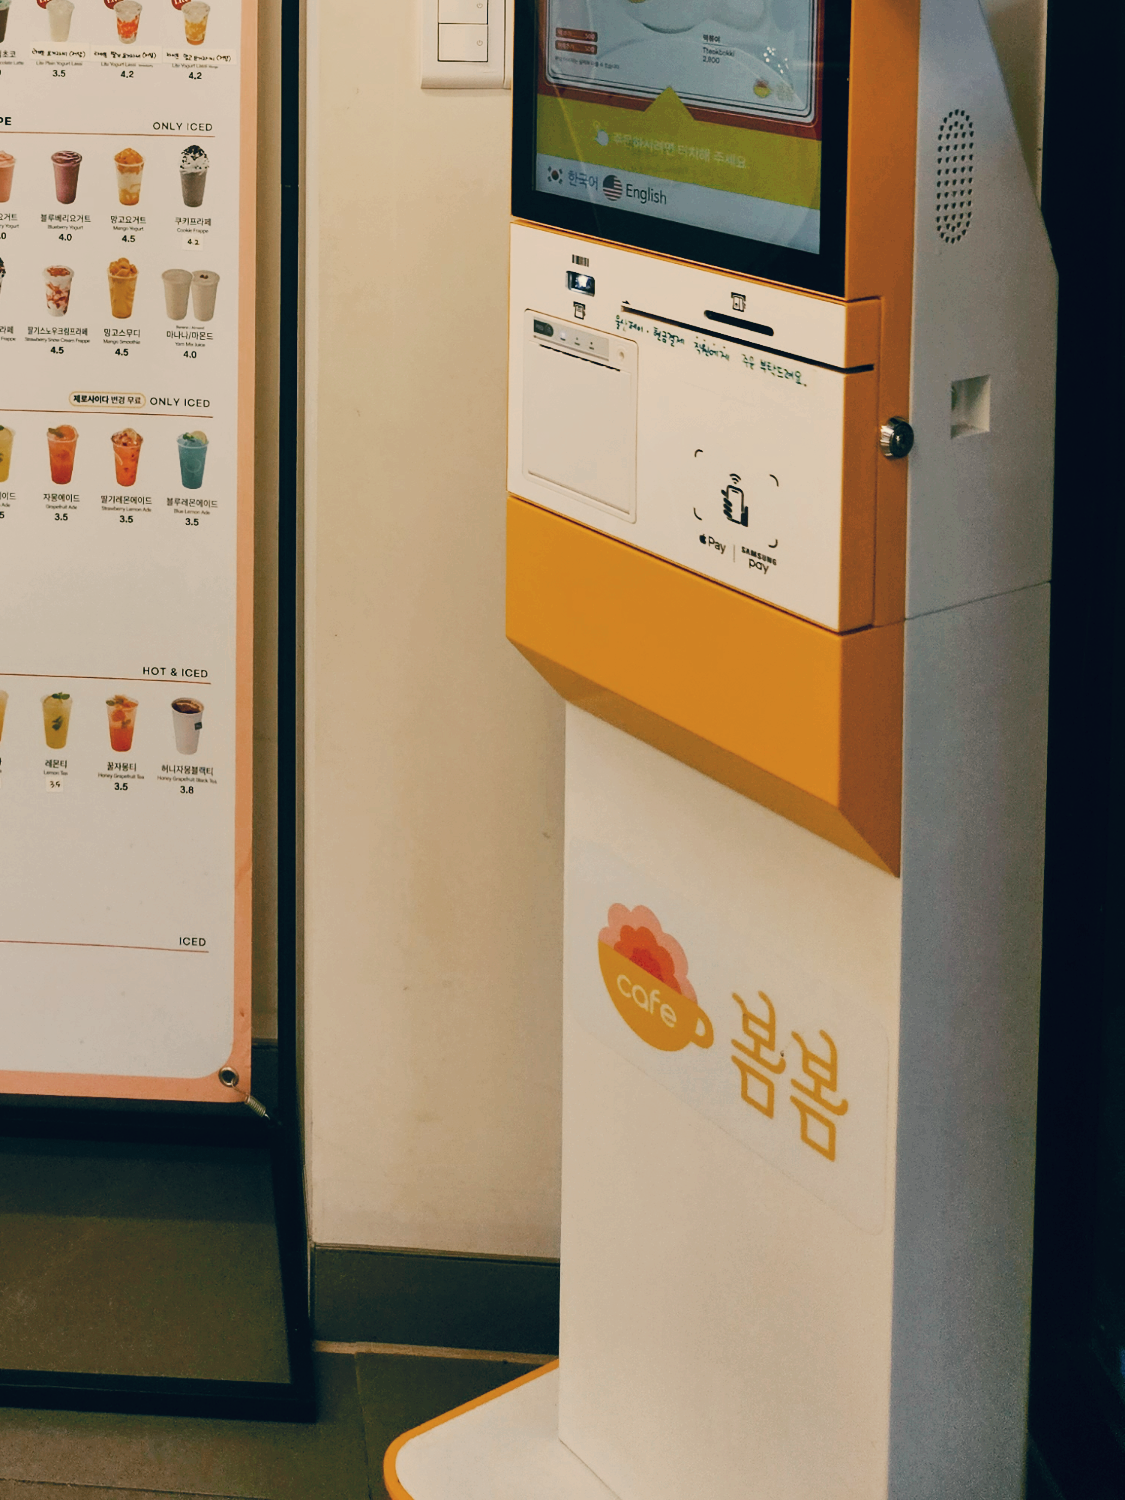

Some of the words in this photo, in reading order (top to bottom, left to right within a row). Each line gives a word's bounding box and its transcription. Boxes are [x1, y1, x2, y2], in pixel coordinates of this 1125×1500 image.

[153, 122, 183, 132] ONLY
[186, 122, 213, 132] ICED
[567, 170, 599, 190] 한국어
[625, 184, 667, 205] English
[111, 215, 147, 224] 망고요거트
[73, 394, 109, 404] 제로사이다
[111, 396, 125, 404] 변경
[127, 396, 141, 404] 무료
[149, 397, 179, 407] ONLY
[184, 398, 211, 408] ICED
[708, 536, 726, 554] Pay
[741, 546, 777, 566] SAMSUNG
[748, 558, 769, 575] pay
[143, 666, 166, 676] HOT
[181, 668, 208, 678] ICED
[179, 937, 206, 946] ICED
[616, 974, 678, 1028] cafe
[731, 990, 849, 1162] 봄봄
